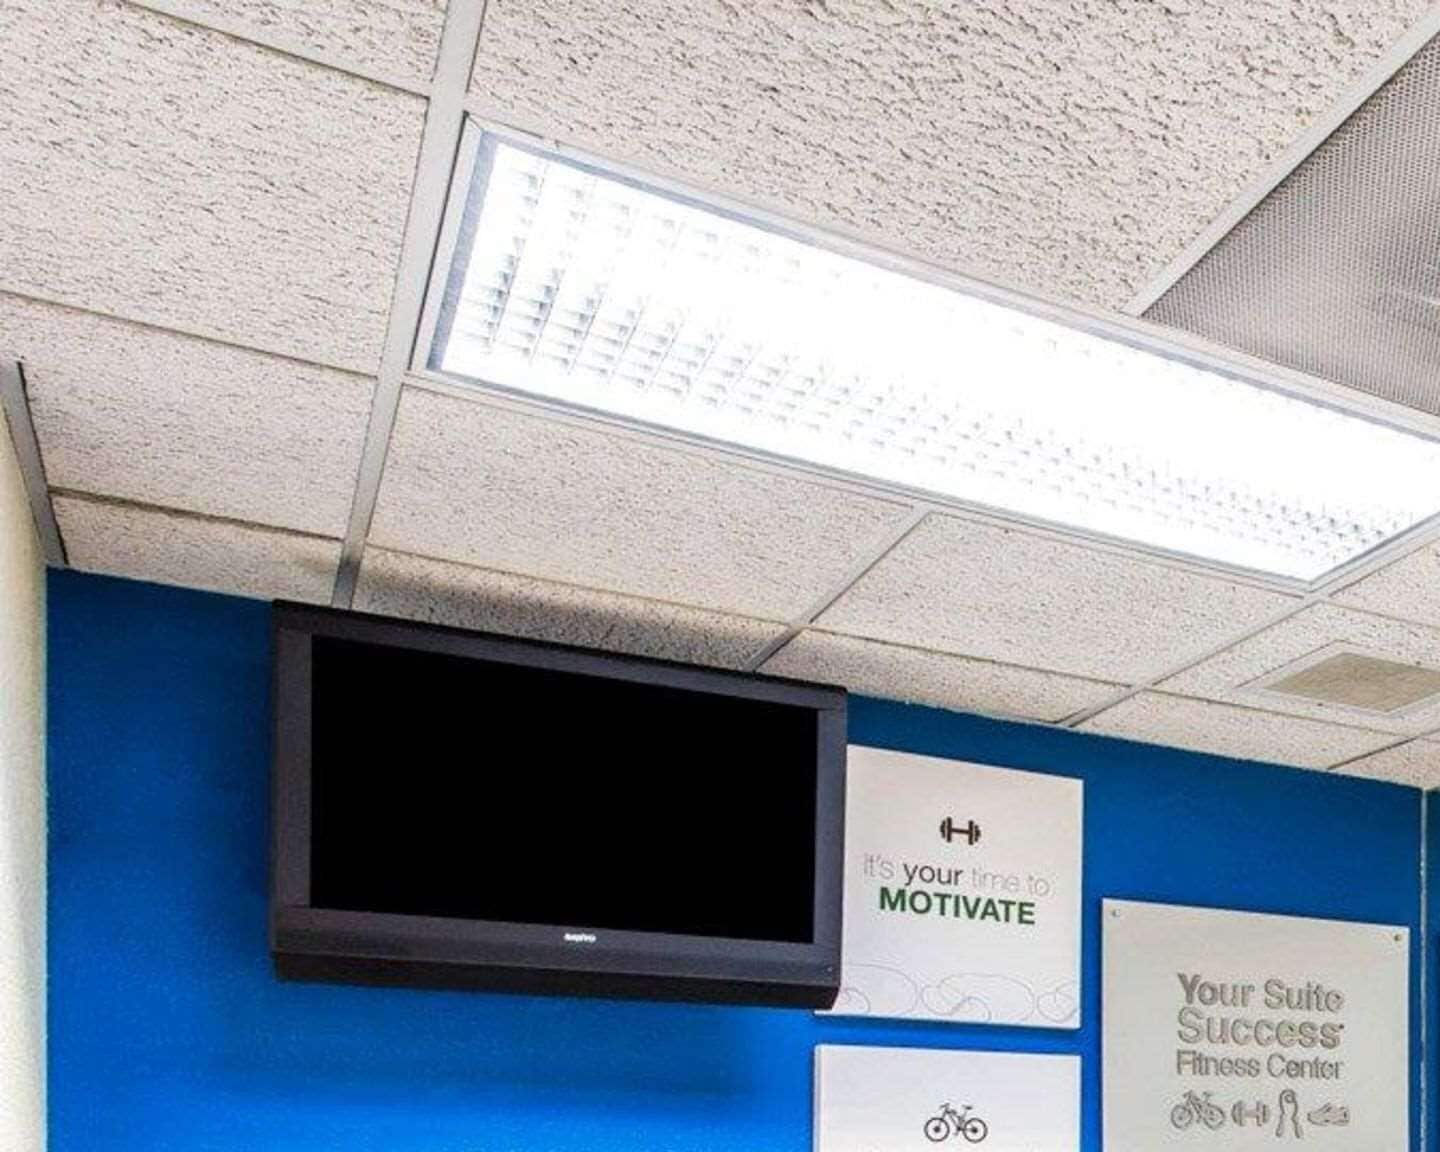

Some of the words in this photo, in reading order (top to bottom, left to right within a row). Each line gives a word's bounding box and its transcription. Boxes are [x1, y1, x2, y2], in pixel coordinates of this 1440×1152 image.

[903, 862, 963, 887] your
[971, 867, 1020, 893] time
[1027, 873, 1050, 896] to
[879, 886, 1036, 925] MOTIVATE
[1177, 972, 1255, 1008] Your
[1263, 978, 1344, 1012] Suite
[1175, 1049, 1260, 1077] Fitness
[1266, 1053, 1344, 1080] Center
